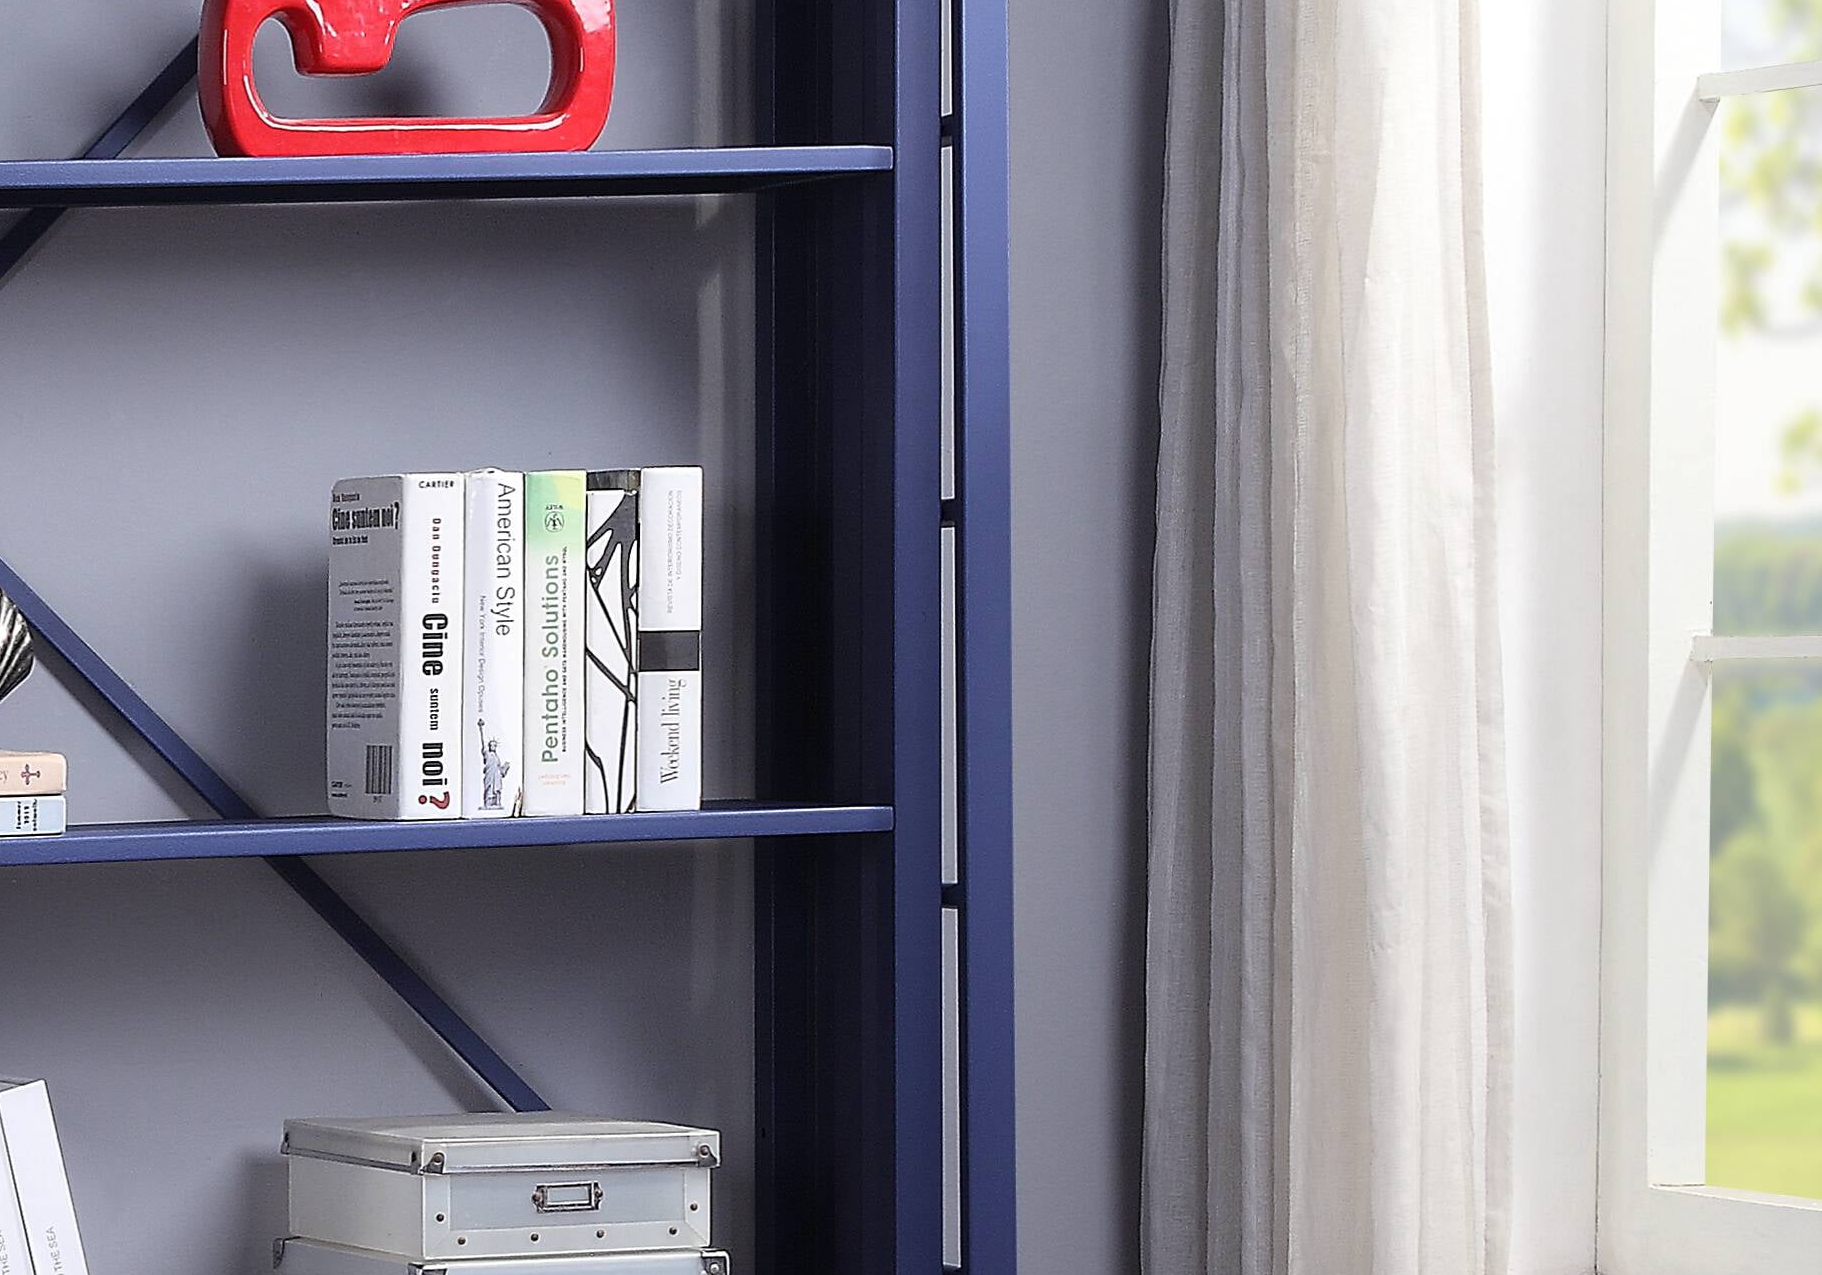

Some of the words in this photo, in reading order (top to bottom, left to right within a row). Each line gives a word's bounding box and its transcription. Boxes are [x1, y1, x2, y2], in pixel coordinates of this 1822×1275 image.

[418, 480, 454, 488] CARTIER
[432, 518, 441, 540] Dan
[496, 482, 516, 579] American
[490, 586, 516, 636] Style
[541, 555, 559, 658] Solutions
[422, 612, 449, 676] Cine
[429, 687, 439, 731] suntem
[541, 668, 559, 762] Pentaho
[661, 679, 687, 716] living
[660, 723, 680, 785] Weekend
[46, 1226, 58, 1249] SEA
[0, 1253, 10, 1275] THE
[51, 1251, 63, 1273] THE
